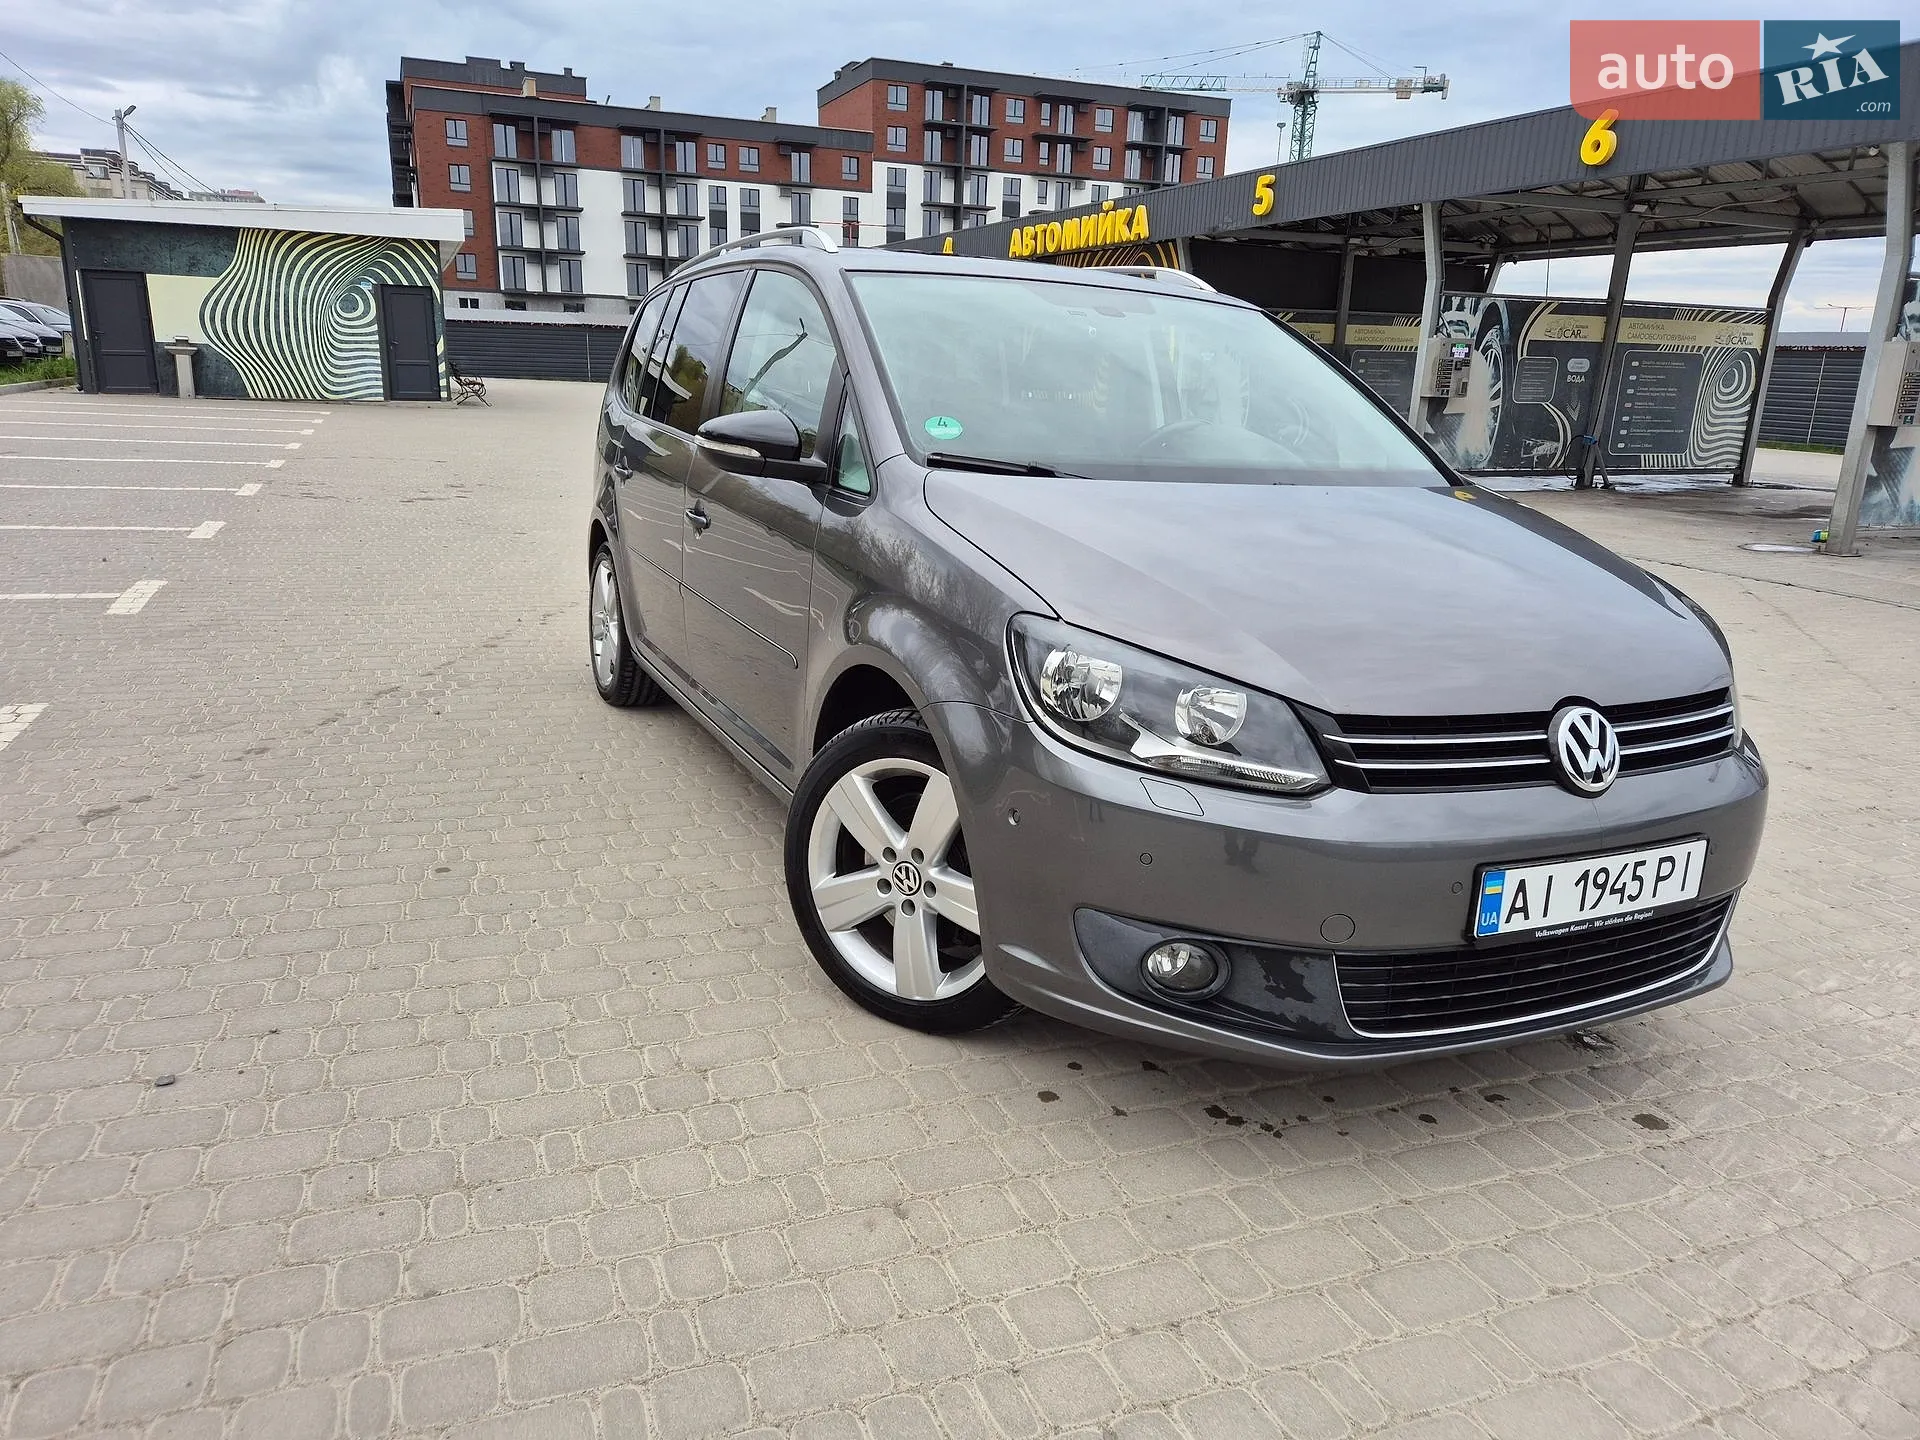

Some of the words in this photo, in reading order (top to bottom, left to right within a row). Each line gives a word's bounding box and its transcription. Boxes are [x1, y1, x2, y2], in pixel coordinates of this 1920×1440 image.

[1580, 109, 1619, 167] 6
[1252, 174, 1276, 216] 5
[1009, 200, 1149, 258] АВТОМИЙКА
[1567, 374, 1586, 384] ВОДА
[937, 417, 947, 427] 4
[1481, 911, 1498, 926] UA
[1535, 927, 1569, 938] Volkswagen
[1569, 922, 1589, 932] Kassel
[1624, 914, 1633, 922] die
